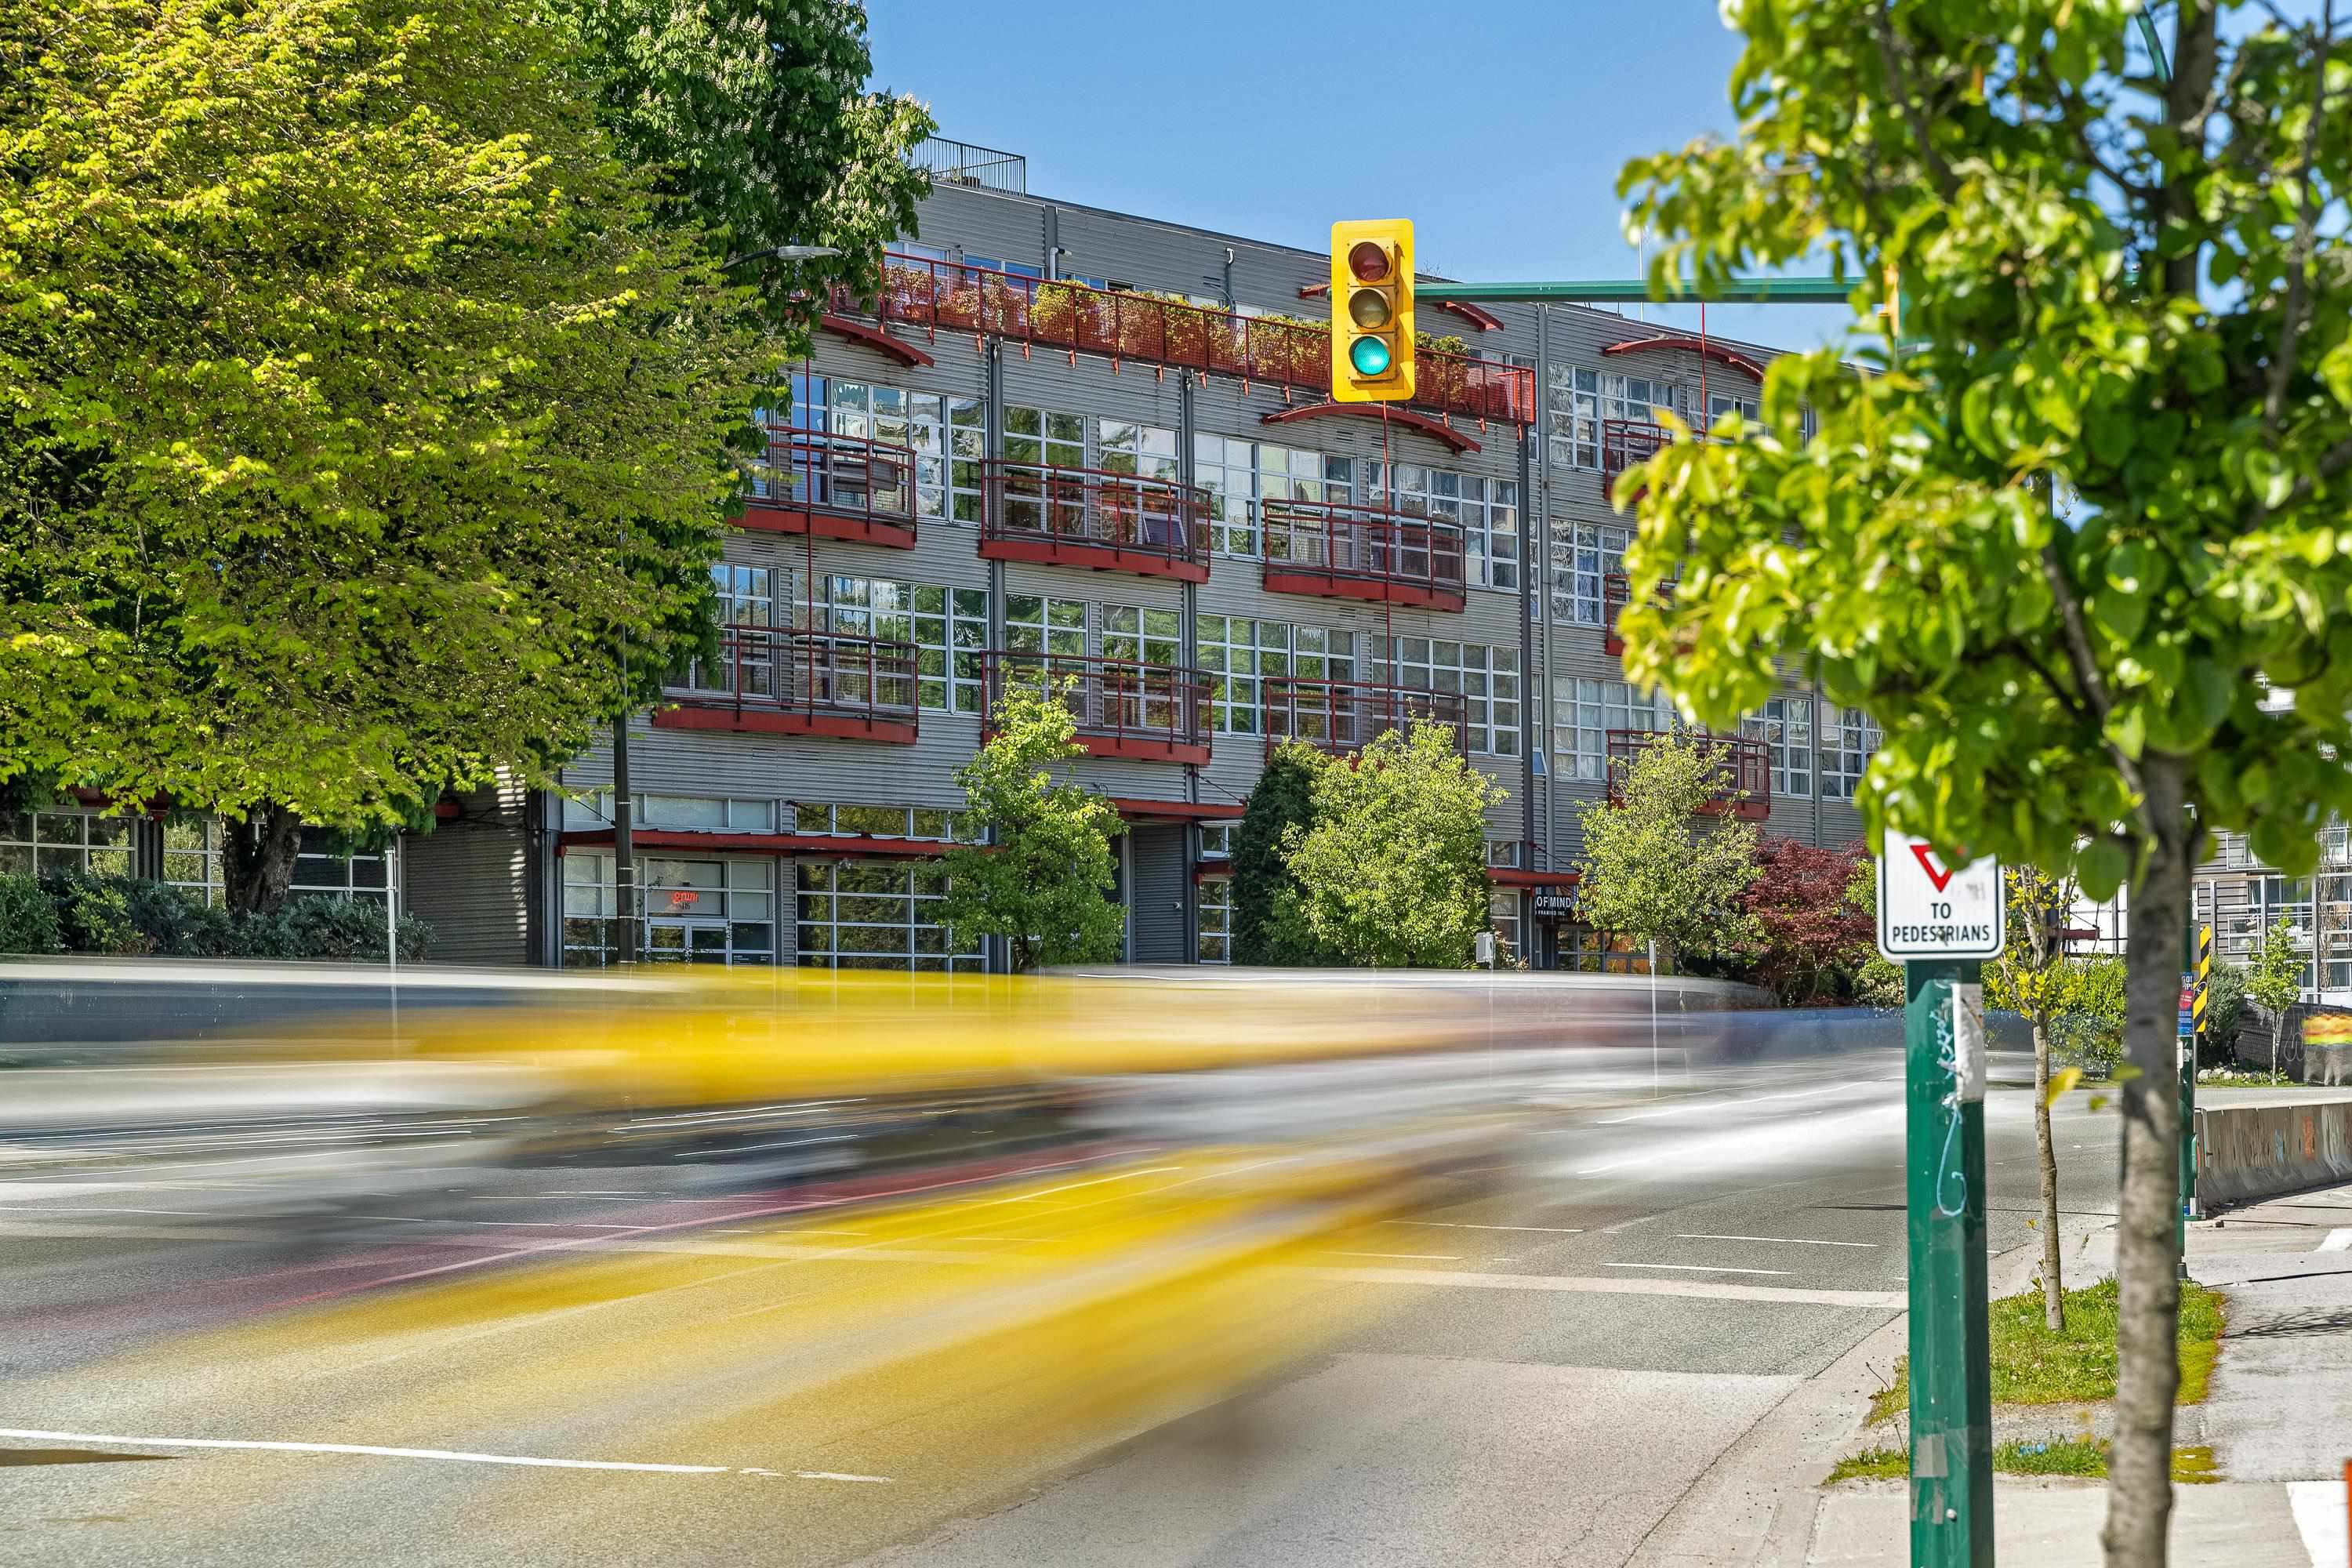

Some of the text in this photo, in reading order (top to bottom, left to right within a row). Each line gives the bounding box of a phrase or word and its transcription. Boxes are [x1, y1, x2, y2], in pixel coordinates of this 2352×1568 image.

[1537, 895, 1571, 908] OF MIND
[1931, 902, 1951, 919] TO
[1893, 925, 1990, 942] PEDESTRIANS
